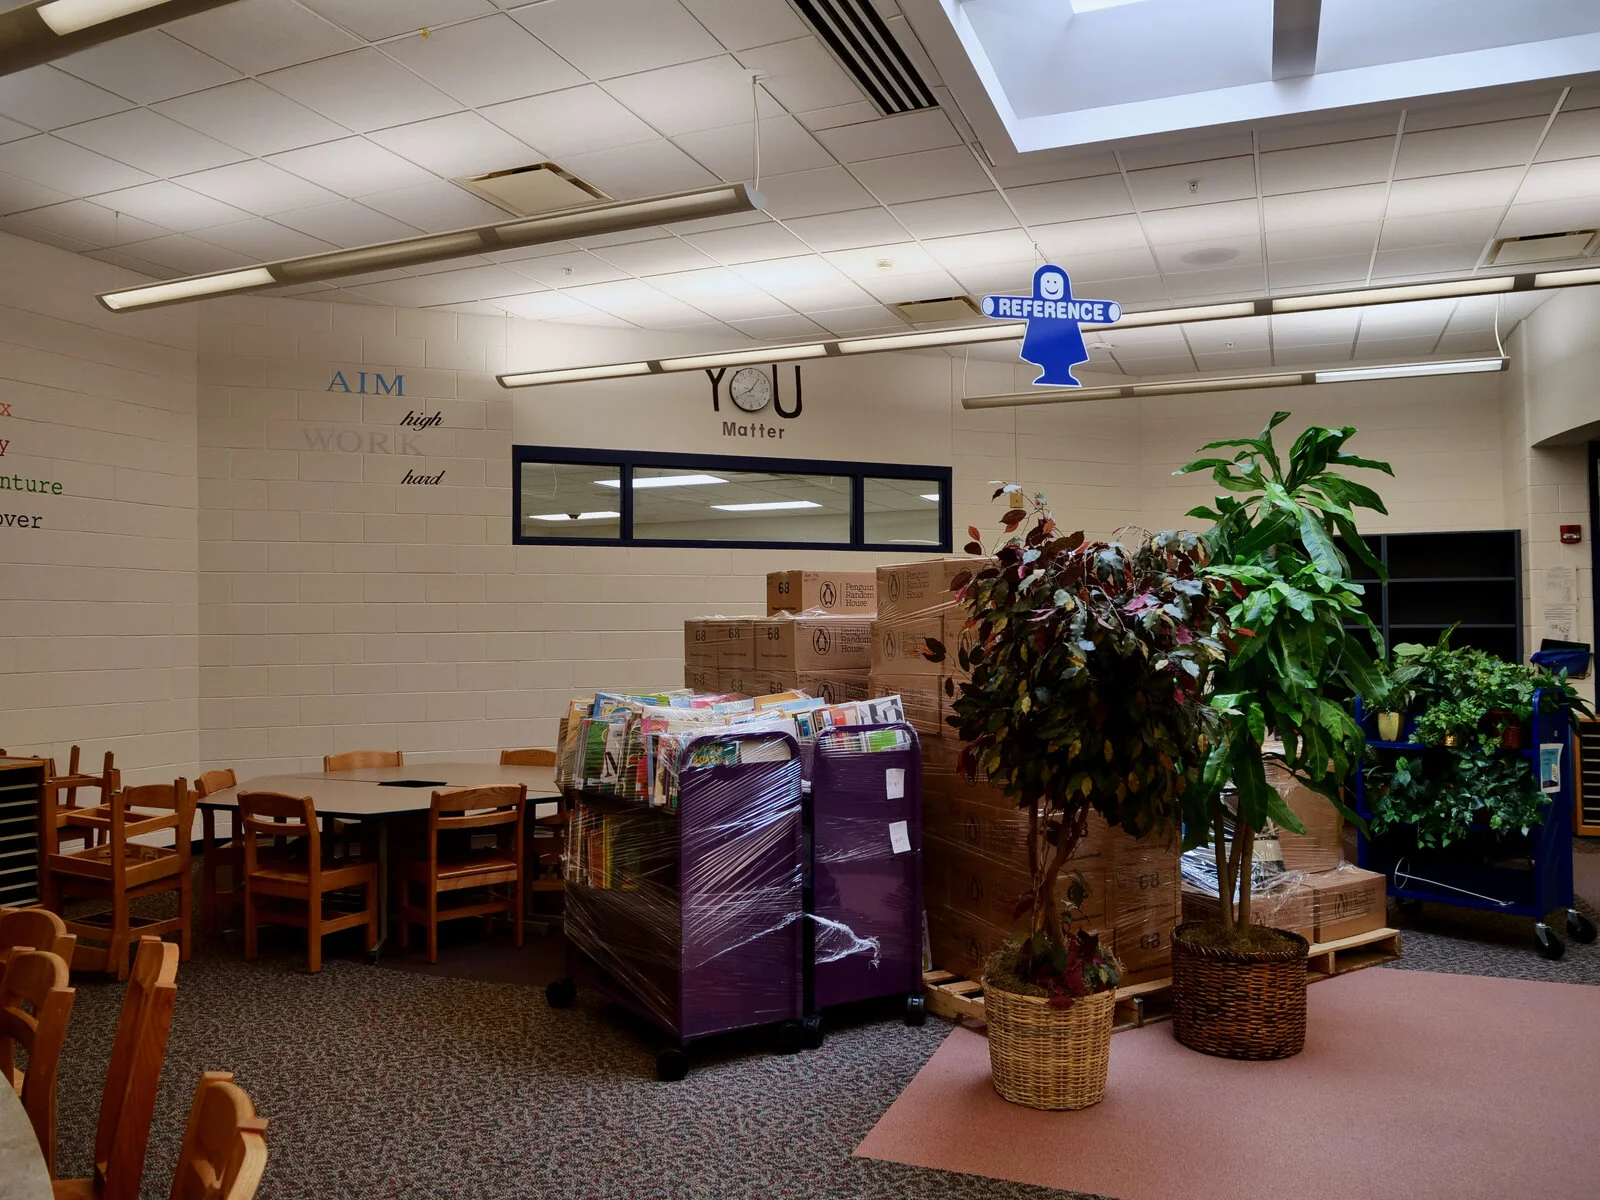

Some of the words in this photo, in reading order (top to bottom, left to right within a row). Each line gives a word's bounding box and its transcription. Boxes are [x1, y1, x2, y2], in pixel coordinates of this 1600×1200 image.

[998, 298, 1104, 321] REFERENCE
[326, 370, 406, 397] AIM
[705, 364, 803, 419] YU
[399, 410, 444, 431] high
[722, 421, 785, 439] Matter
[300, 427, 424, 456] WORK
[400, 469, 446, 485] hard
[0, 513, 43, 529] ver
[778, 582, 790, 594] 68
[845, 583, 874, 591] Penguin
[845, 599, 868, 607] House
[728, 627, 740, 639] 68
[767, 627, 780, 641] 68
[841, 645, 865, 653] House
[1139, 931, 1161, 950] 68
